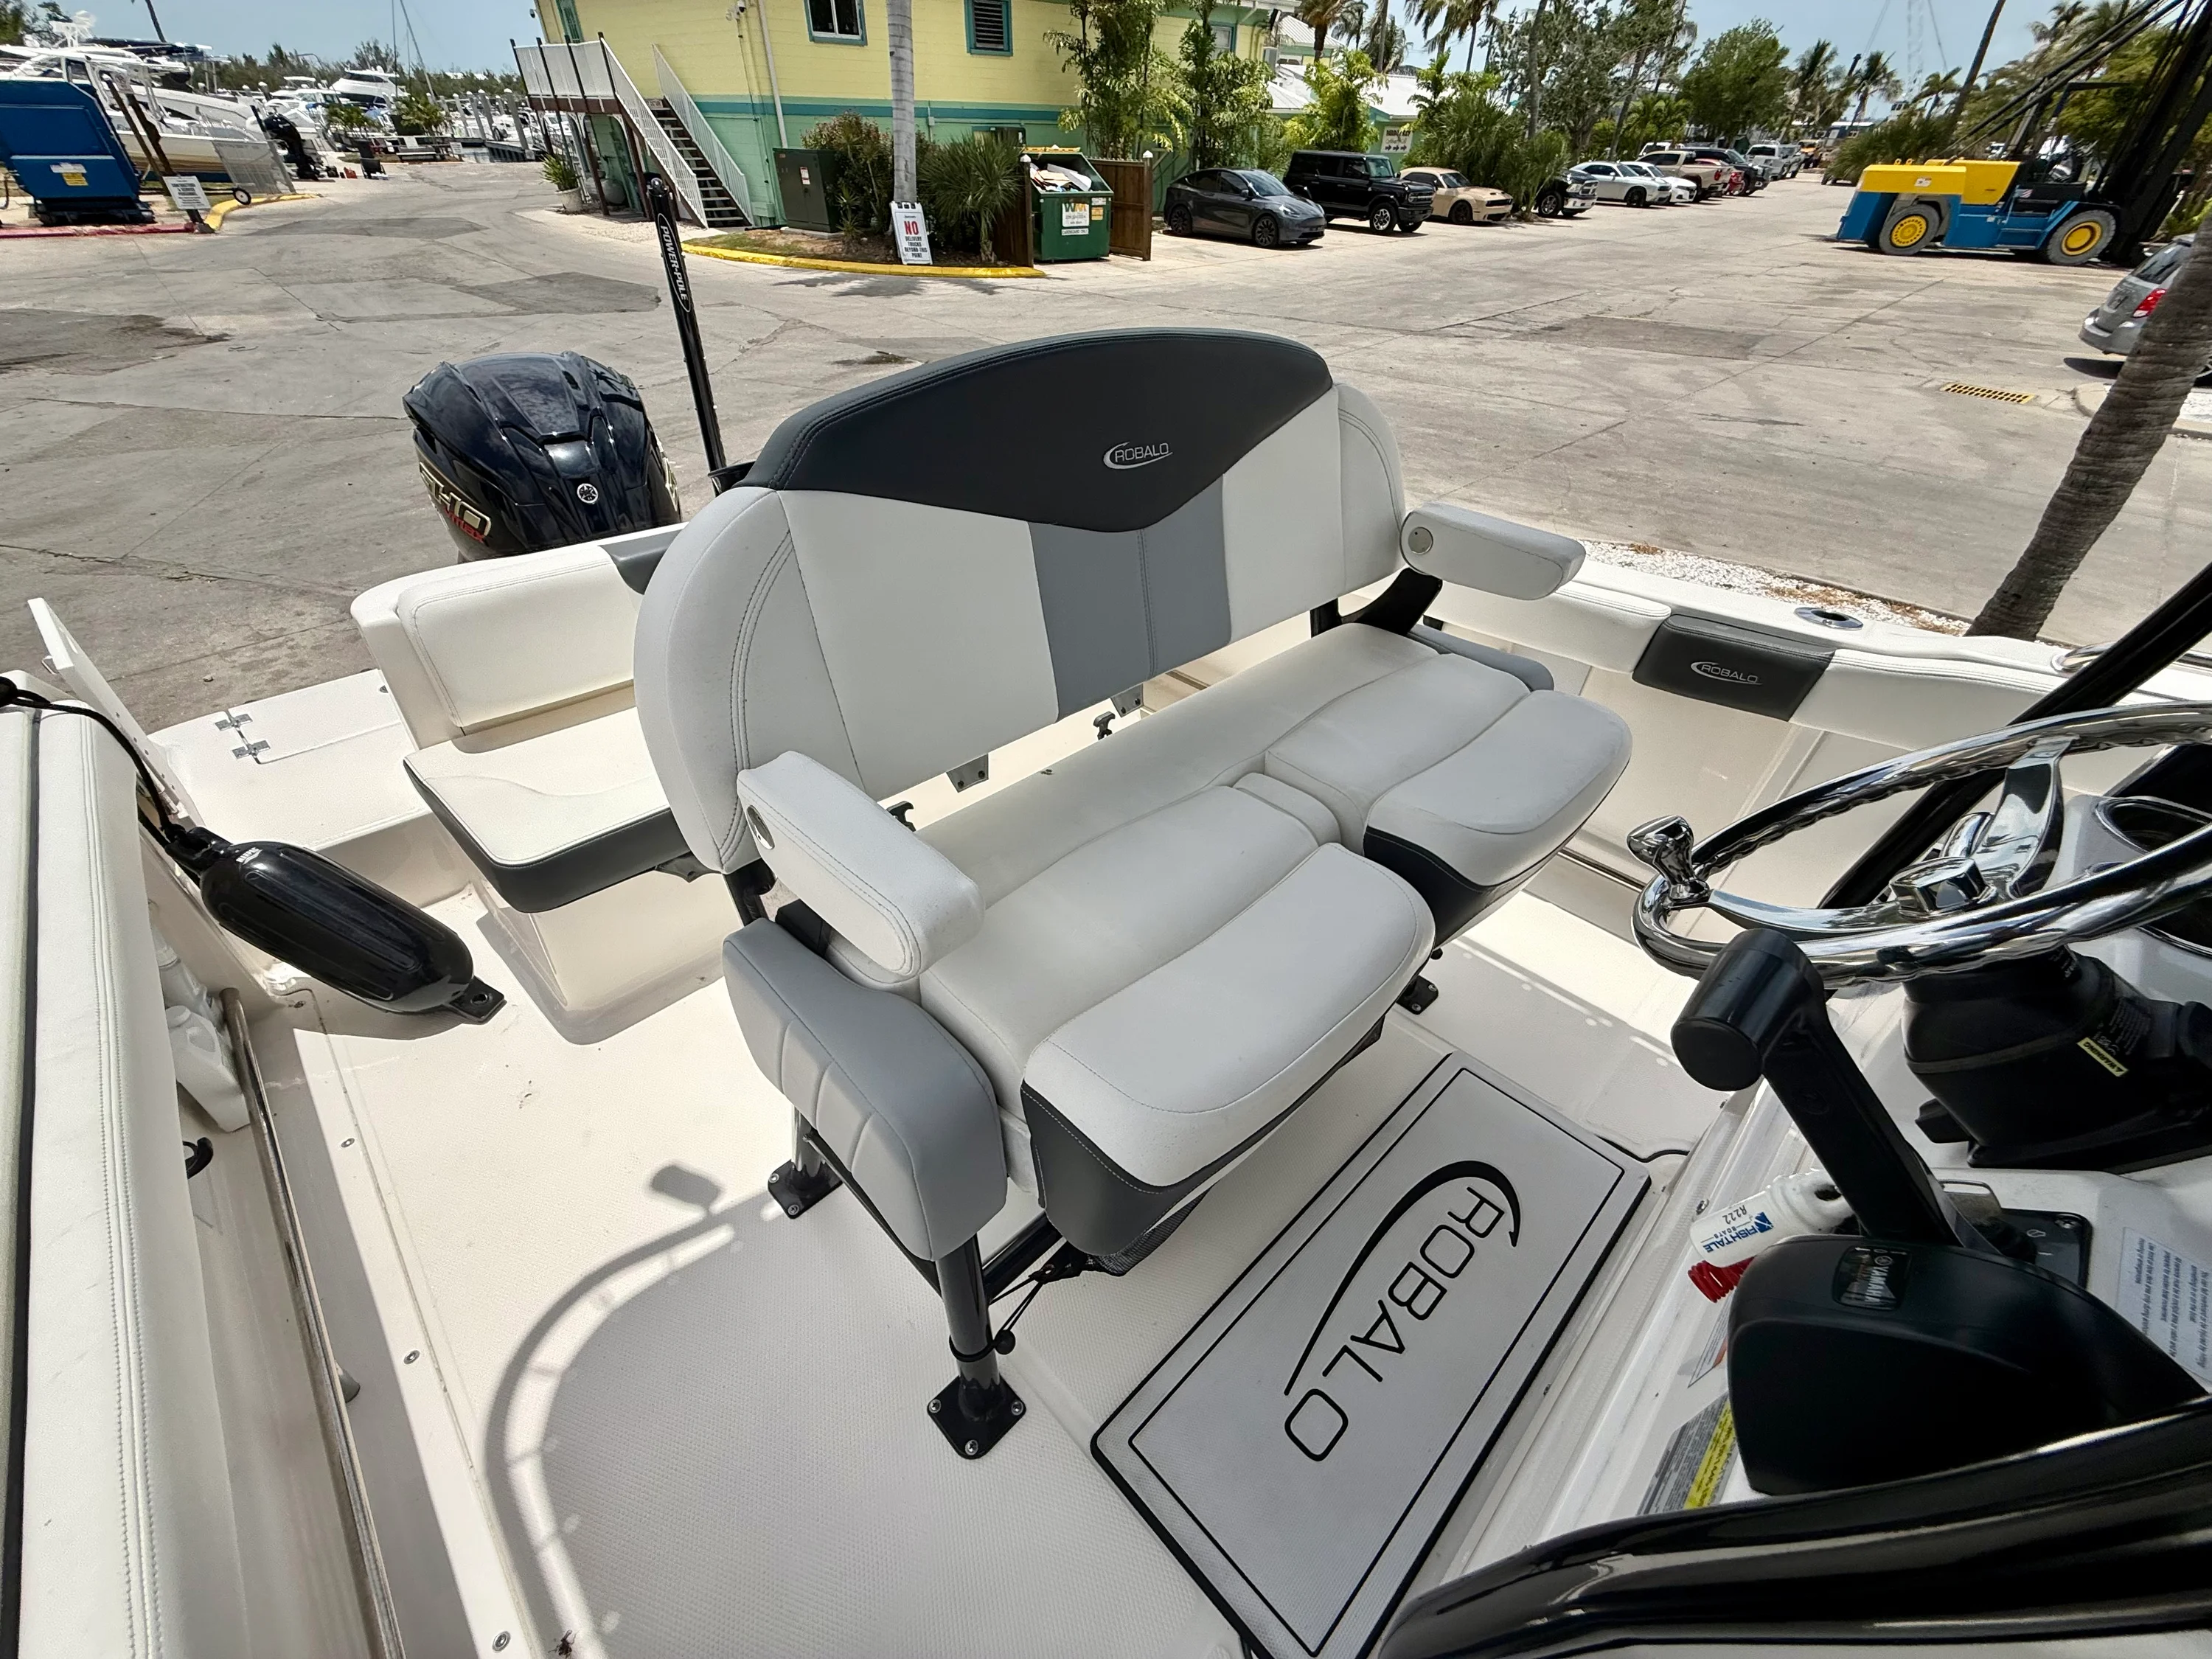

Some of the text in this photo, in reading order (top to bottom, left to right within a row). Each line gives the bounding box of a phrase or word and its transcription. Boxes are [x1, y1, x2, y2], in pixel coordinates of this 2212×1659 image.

[904, 220, 919, 235] NO
[661, 226, 689, 301] POWER-POLE
[1115, 442, 1169, 462] ROBALO
[1701, 664, 1759, 683] ROBALO
[2084, 1041, 2116, 1068] WARNING
[1722, 1205, 1747, 1224] R222
[1703, 1225, 1758, 1253] FISHTALE
[1714, 1226, 1737, 1239] BOATS
[1865, 1266, 1889, 1302] YAMAHA
[1284, 1186, 1505, 1461] ROBALO
